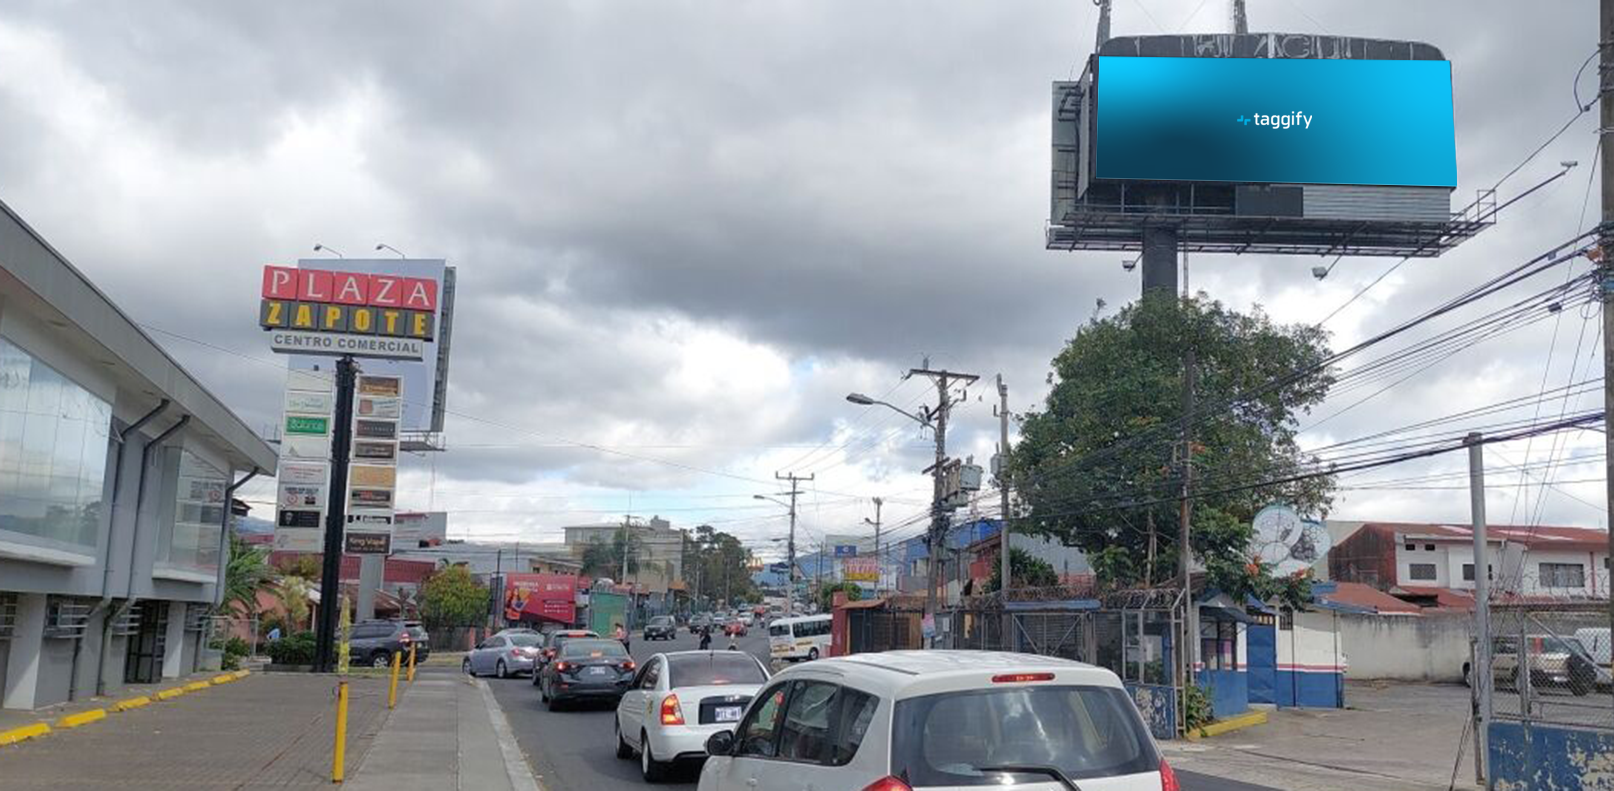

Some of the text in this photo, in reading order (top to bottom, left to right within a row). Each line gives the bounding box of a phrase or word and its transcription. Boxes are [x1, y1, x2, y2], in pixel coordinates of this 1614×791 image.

[1253, 110, 1313, 130] taggify
[270, 270, 430, 307] PLAZA
[267, 302, 426, 336] ZAPOTE
[274, 334, 419, 354] CENTRO COMERCIAL
